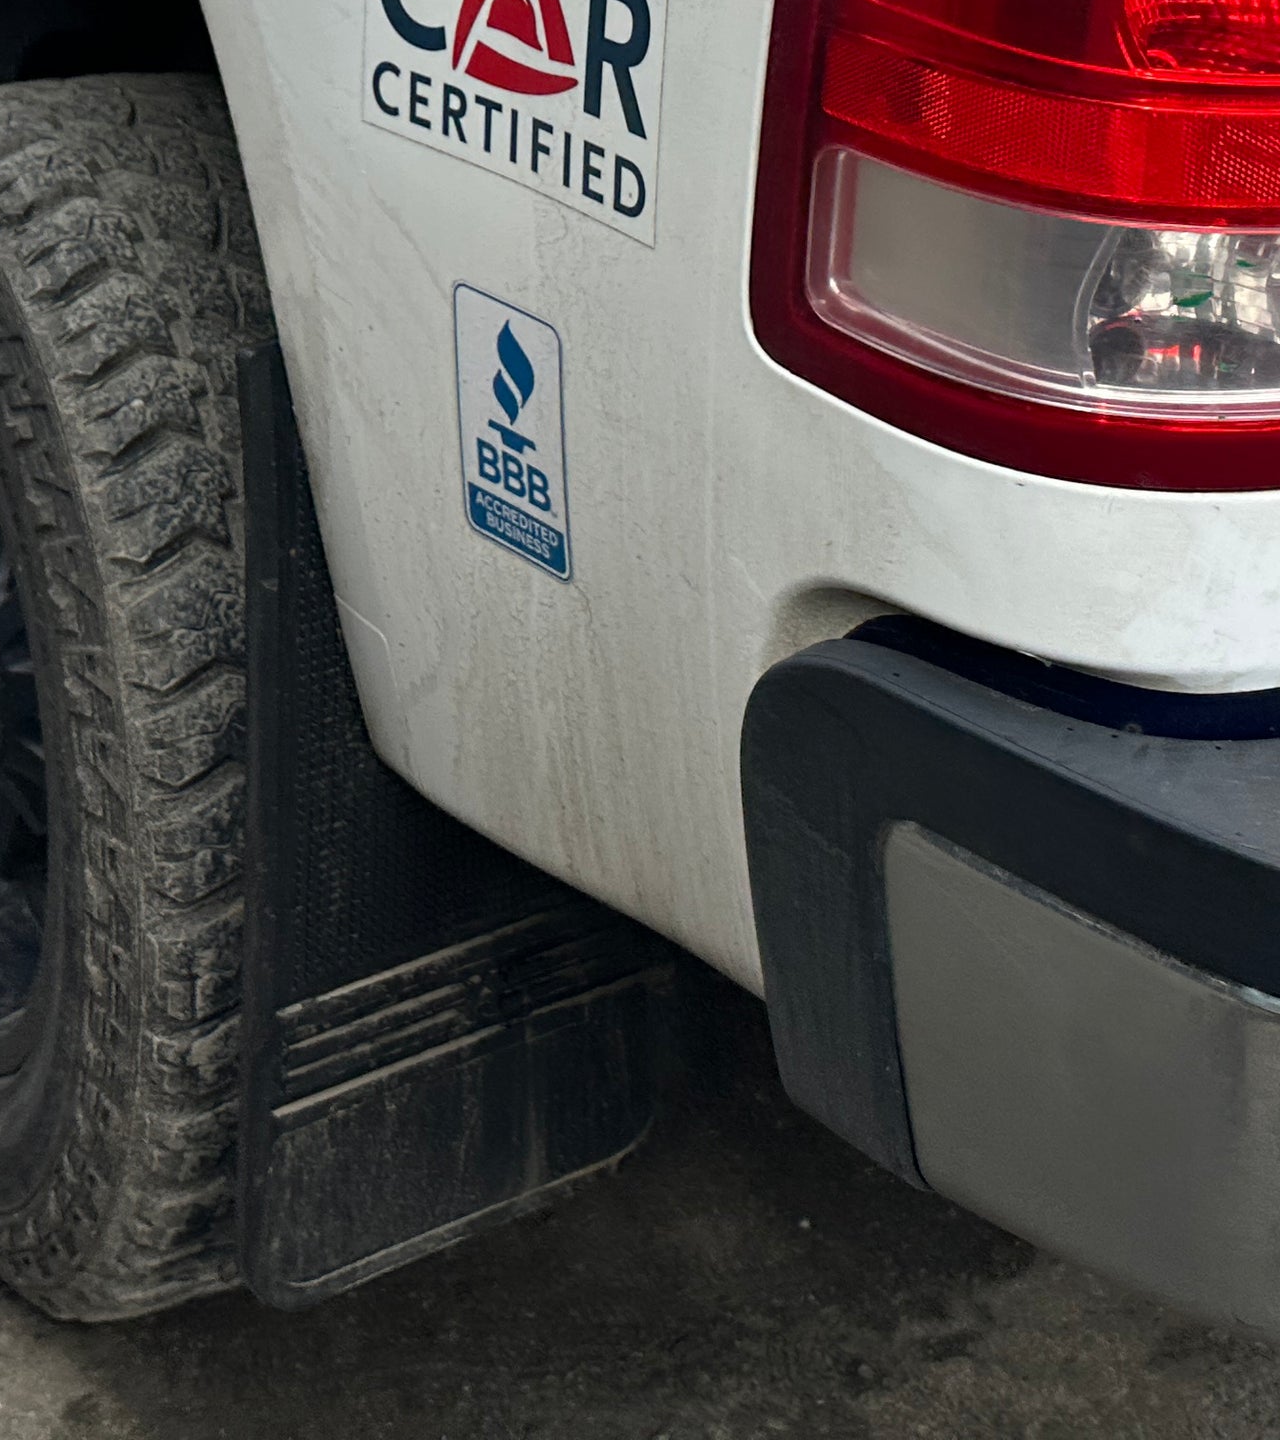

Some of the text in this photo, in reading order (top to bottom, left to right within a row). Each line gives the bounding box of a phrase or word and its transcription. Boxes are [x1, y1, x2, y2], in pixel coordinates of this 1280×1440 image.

[372, 61, 646, 218] CERTIFIED
[476, 437, 552, 511] BBB
[475, 489, 559, 547] ACCREDITED
[486, 510, 551, 560] BUSINESS
